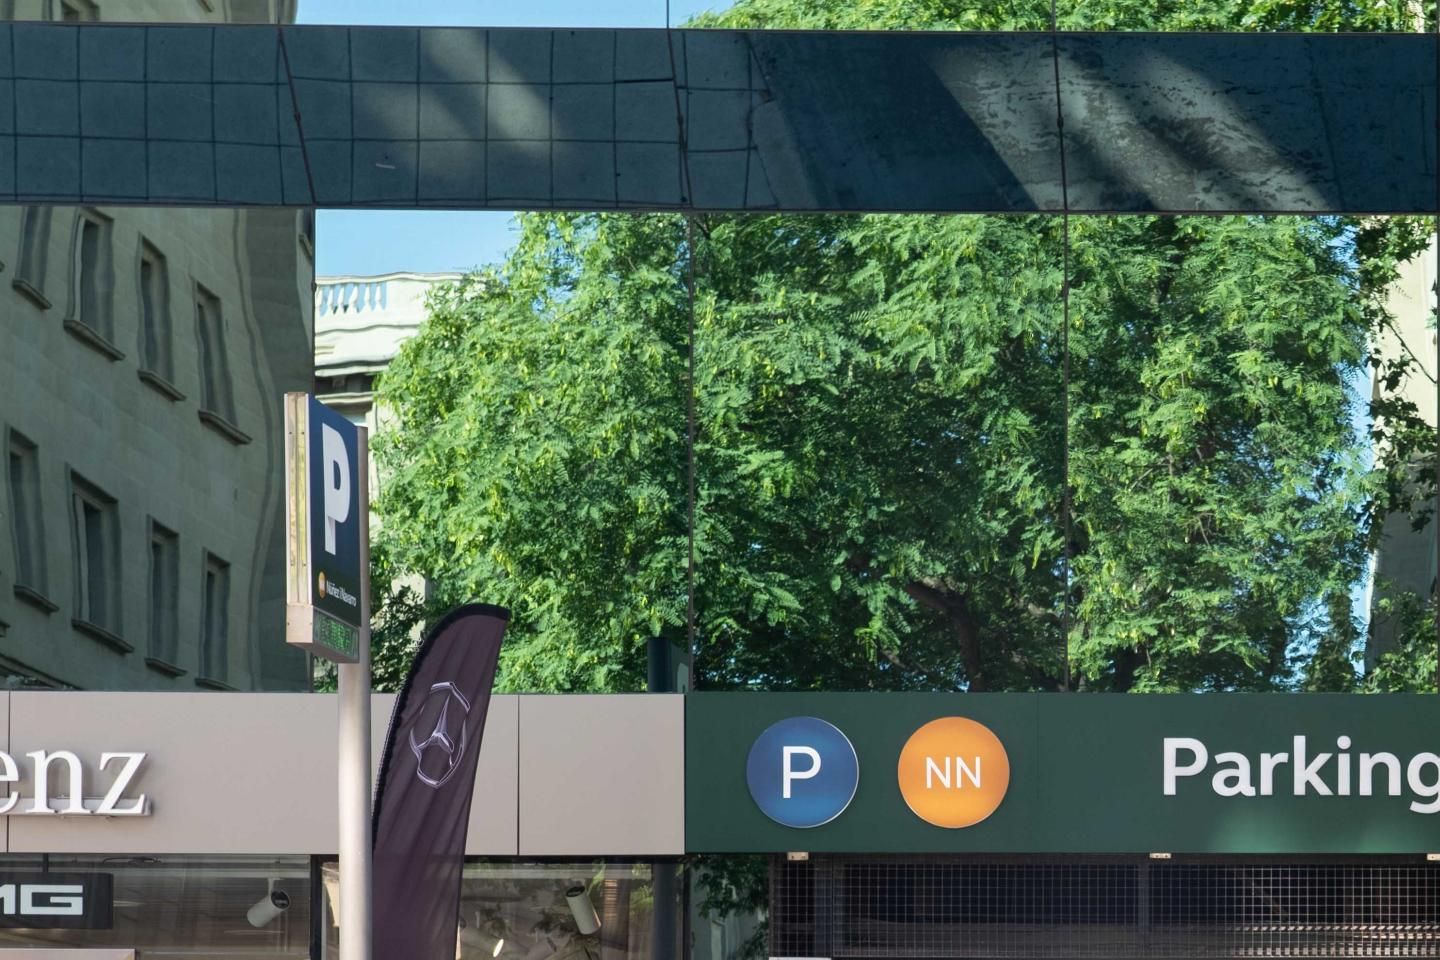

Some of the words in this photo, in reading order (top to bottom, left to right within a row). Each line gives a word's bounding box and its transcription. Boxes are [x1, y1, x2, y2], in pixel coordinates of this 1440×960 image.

[322, 422, 351, 556] P
[784, 747, 822, 799] P
[927, 757, 981, 788] NN
[0, 884, 84, 915] G
